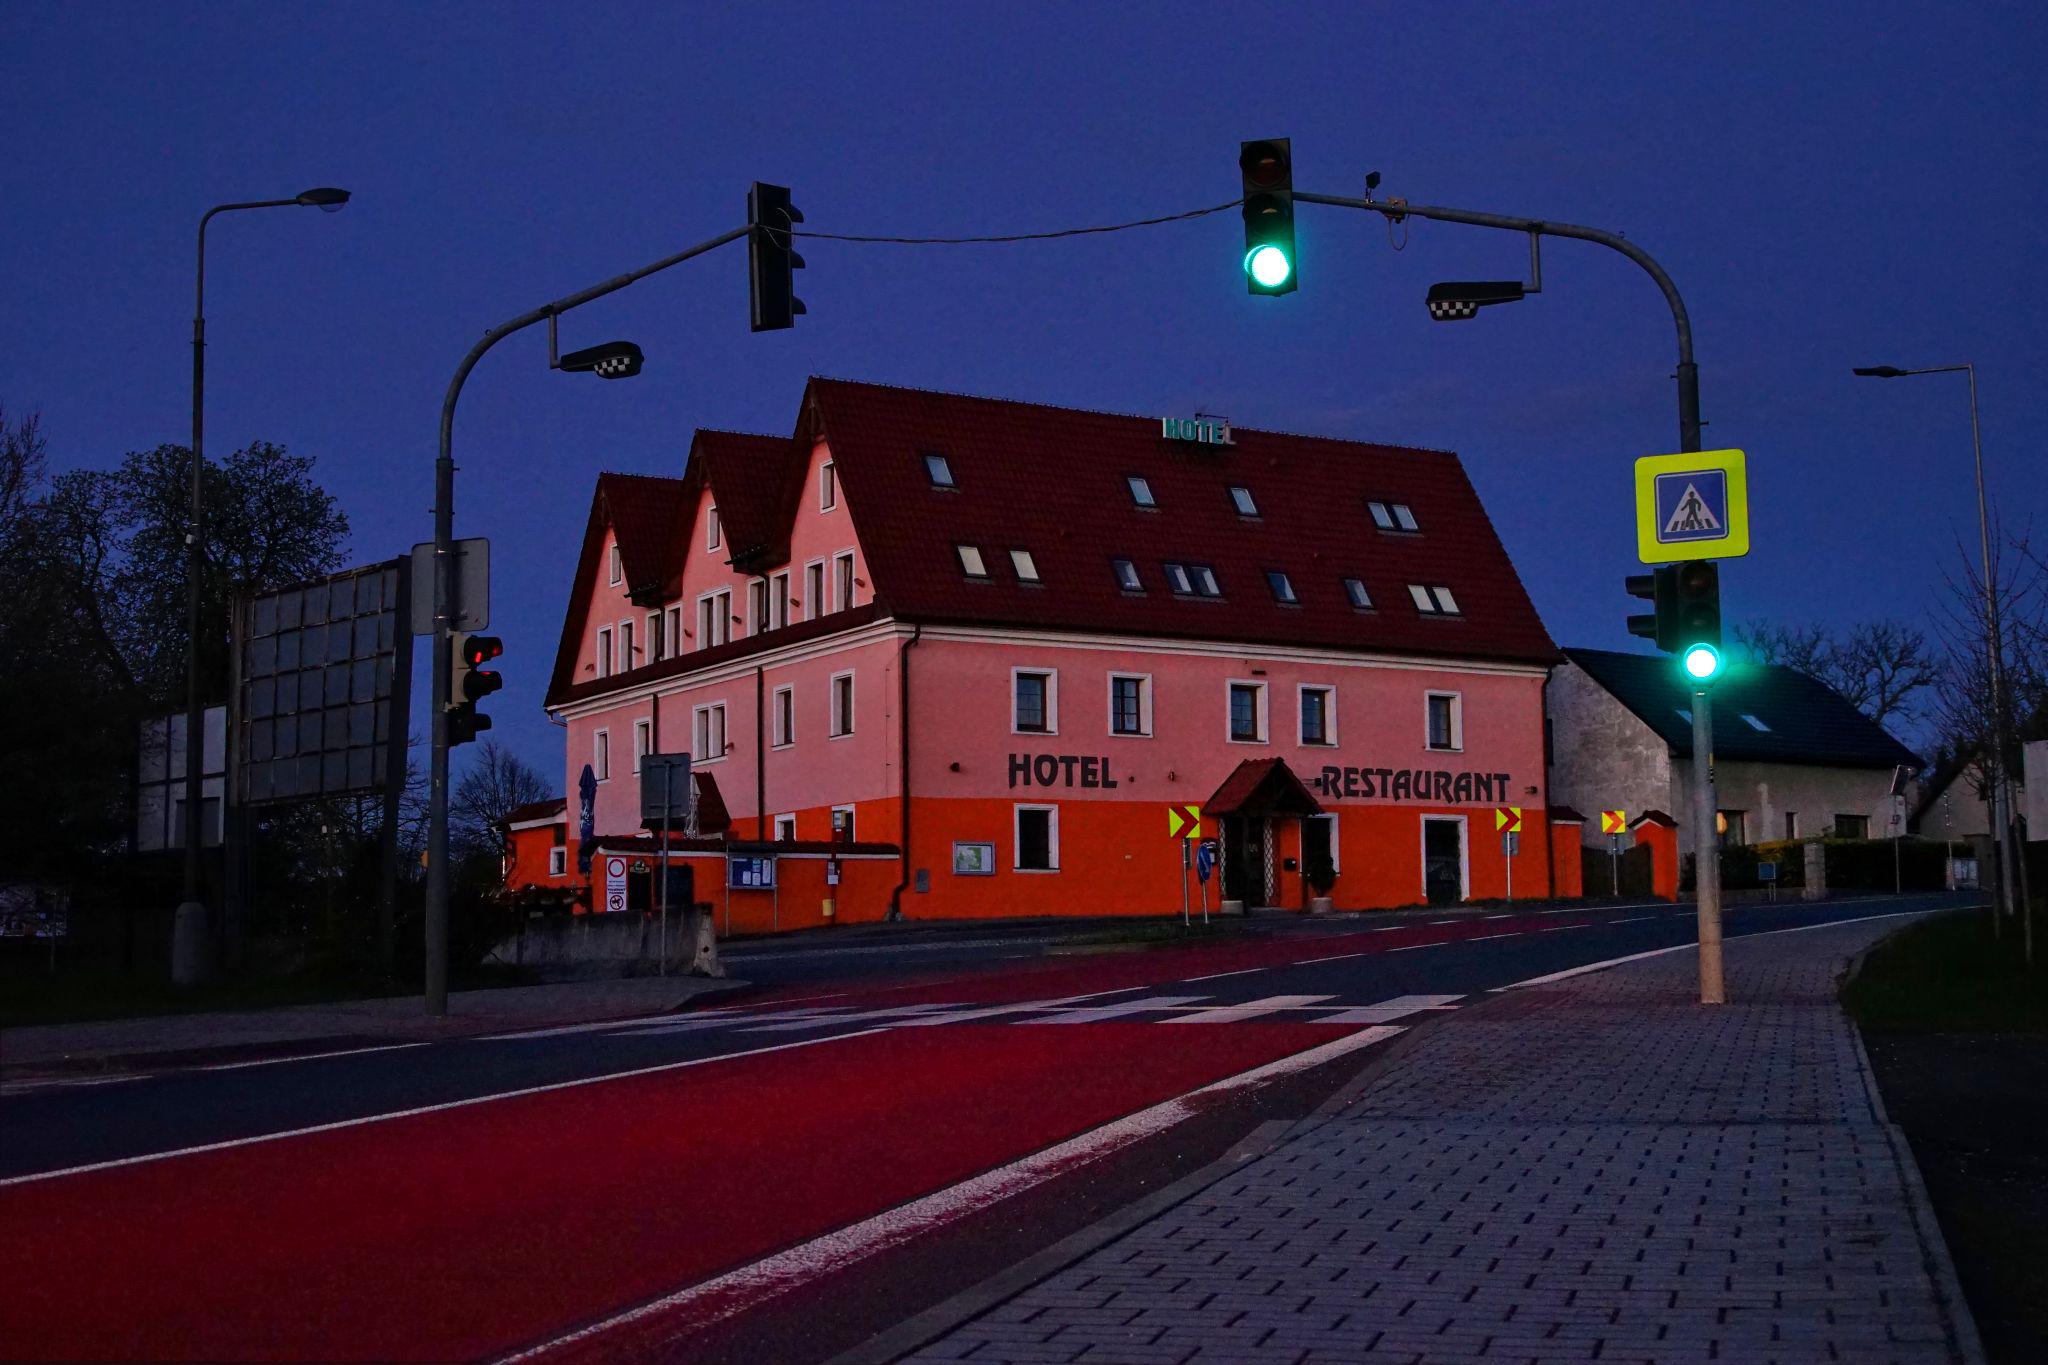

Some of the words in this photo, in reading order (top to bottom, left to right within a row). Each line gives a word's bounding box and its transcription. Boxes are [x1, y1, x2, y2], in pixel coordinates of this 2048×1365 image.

[1163, 417, 1236, 444] HOTEL
[1009, 754, 1117, 789] HOTEL
[1322, 766, 1511, 804] RESTAURANT
